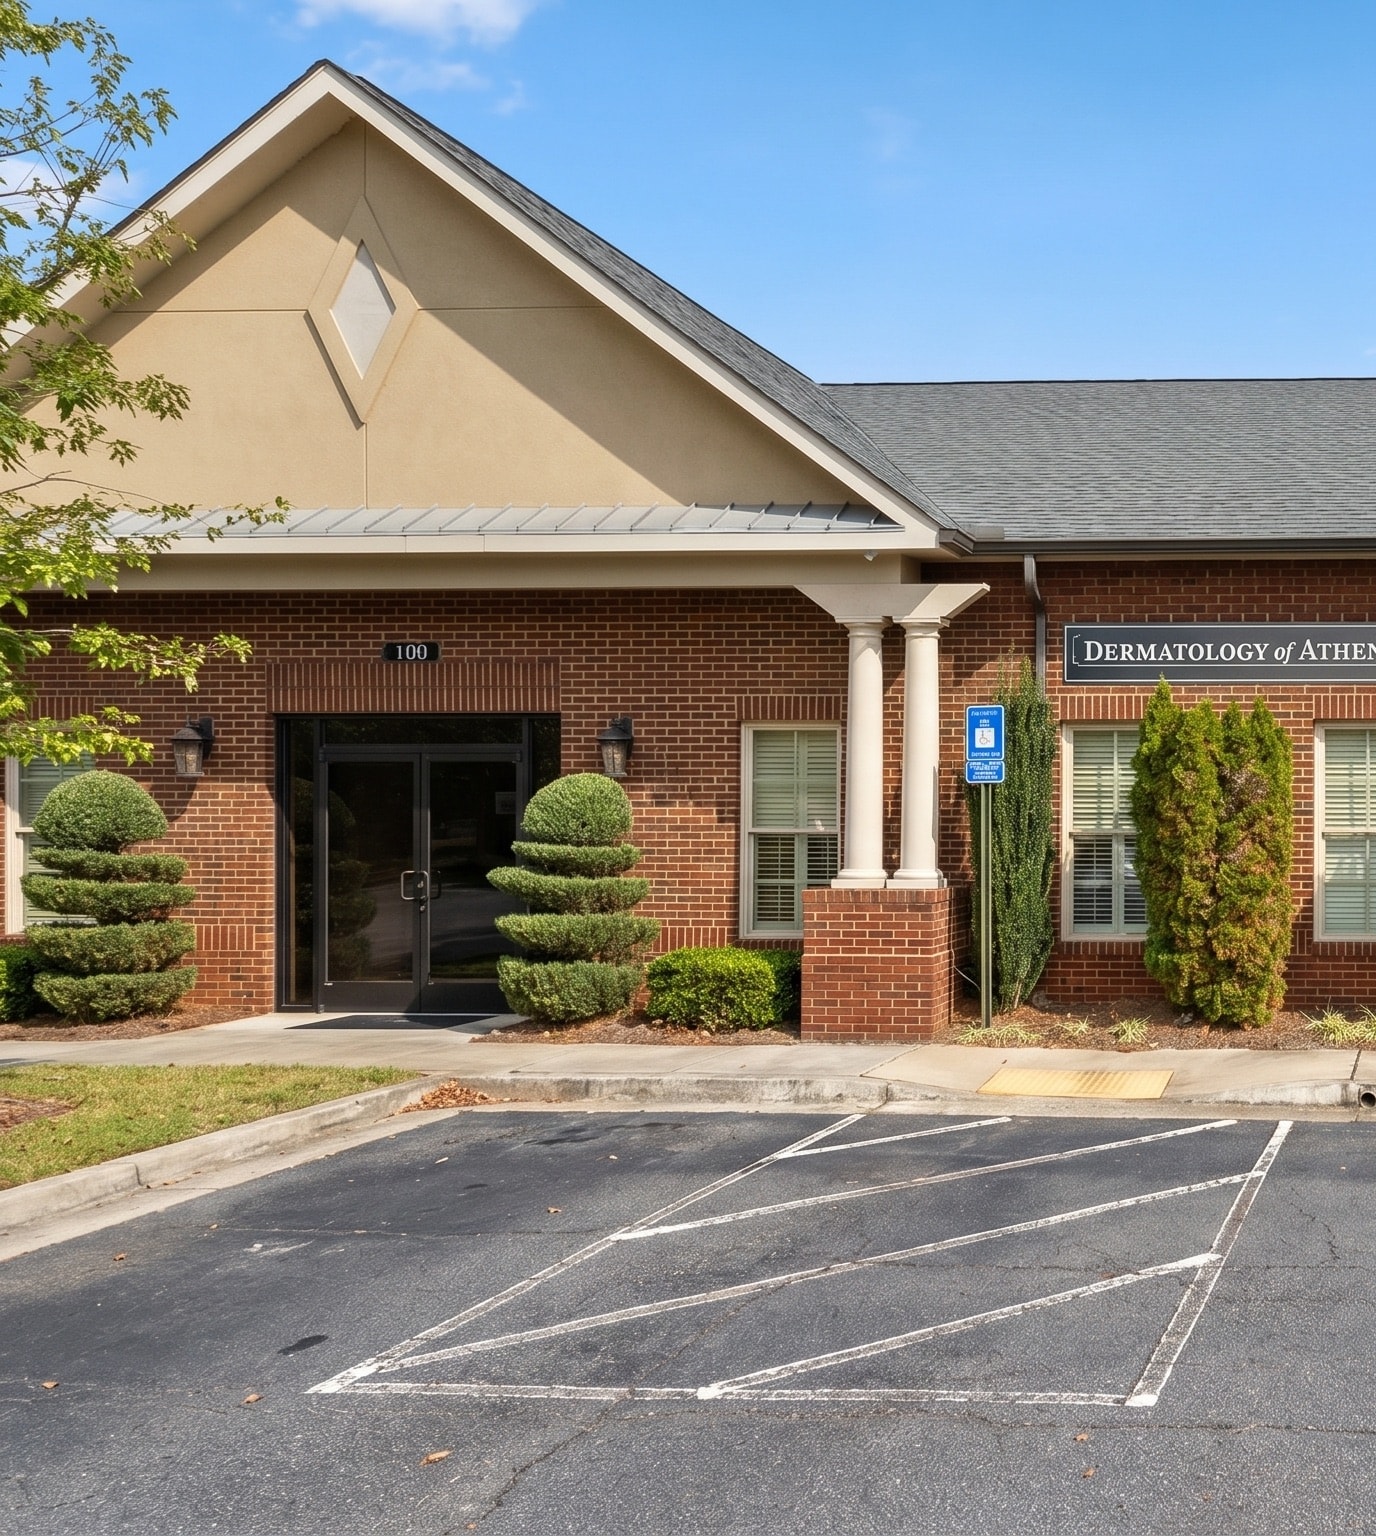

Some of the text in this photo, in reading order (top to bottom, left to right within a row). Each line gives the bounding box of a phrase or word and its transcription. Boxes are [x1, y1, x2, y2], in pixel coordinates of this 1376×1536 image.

[396, 644, 428, 660] 100
[1083, 640, 1269, 662] DERMATOLOGY
[1273, 641, 1297, 665] of
